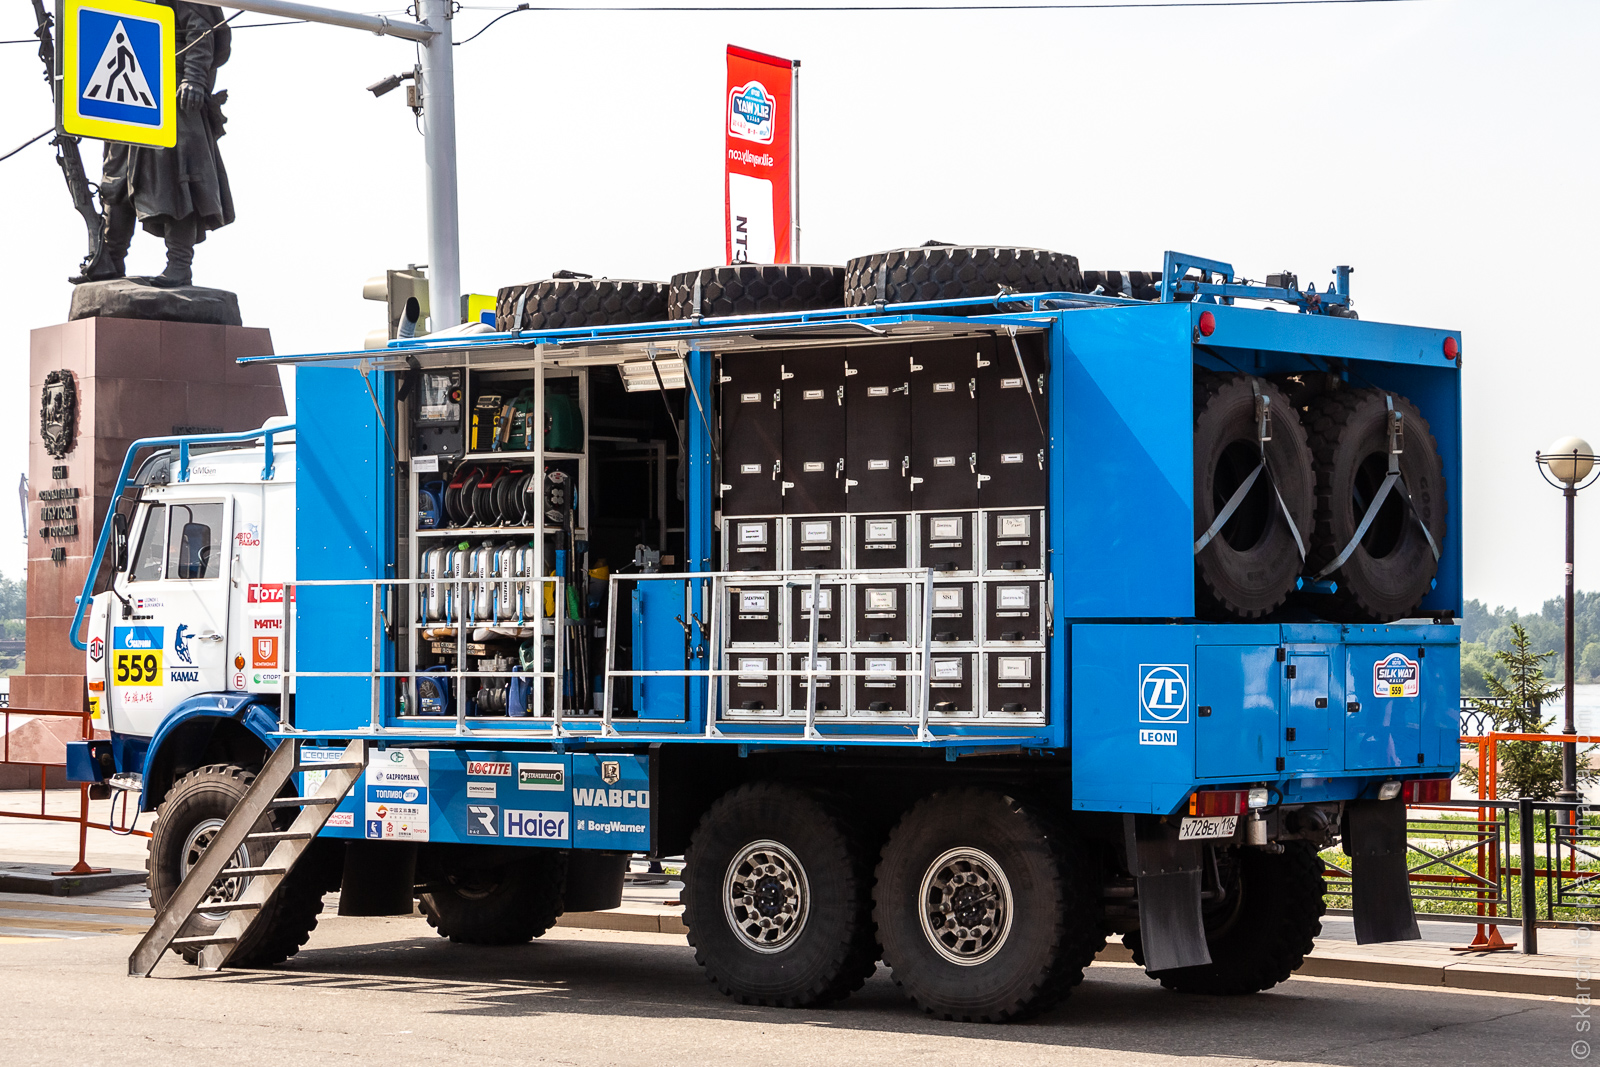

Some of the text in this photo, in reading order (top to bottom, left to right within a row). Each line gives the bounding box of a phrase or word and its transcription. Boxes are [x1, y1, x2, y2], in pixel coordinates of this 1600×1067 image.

[235, 532, 252, 540] АВТО
[239, 539, 260, 547] РАДИО
[117, 654, 158, 682] 559
[171, 671, 199, 682] KAMAZ
[1378, 669, 1415, 678] SILK WAY
[1146, 678, 1183, 708] ZF
[1391, 686, 1402, 695] 559
[1141, 732, 1176, 742] LEONI
[303, 751, 343, 760] ICEQUEE
[468, 762, 511, 775] LOCTITE
[386, 773, 420, 781] GAZPROMBANK
[376, 790, 403, 799] ТОПЛИВО
[572, 788, 650, 809] WABCO
[508, 812, 564, 838] Haier
[588, 820, 646, 834] BorgWarner
